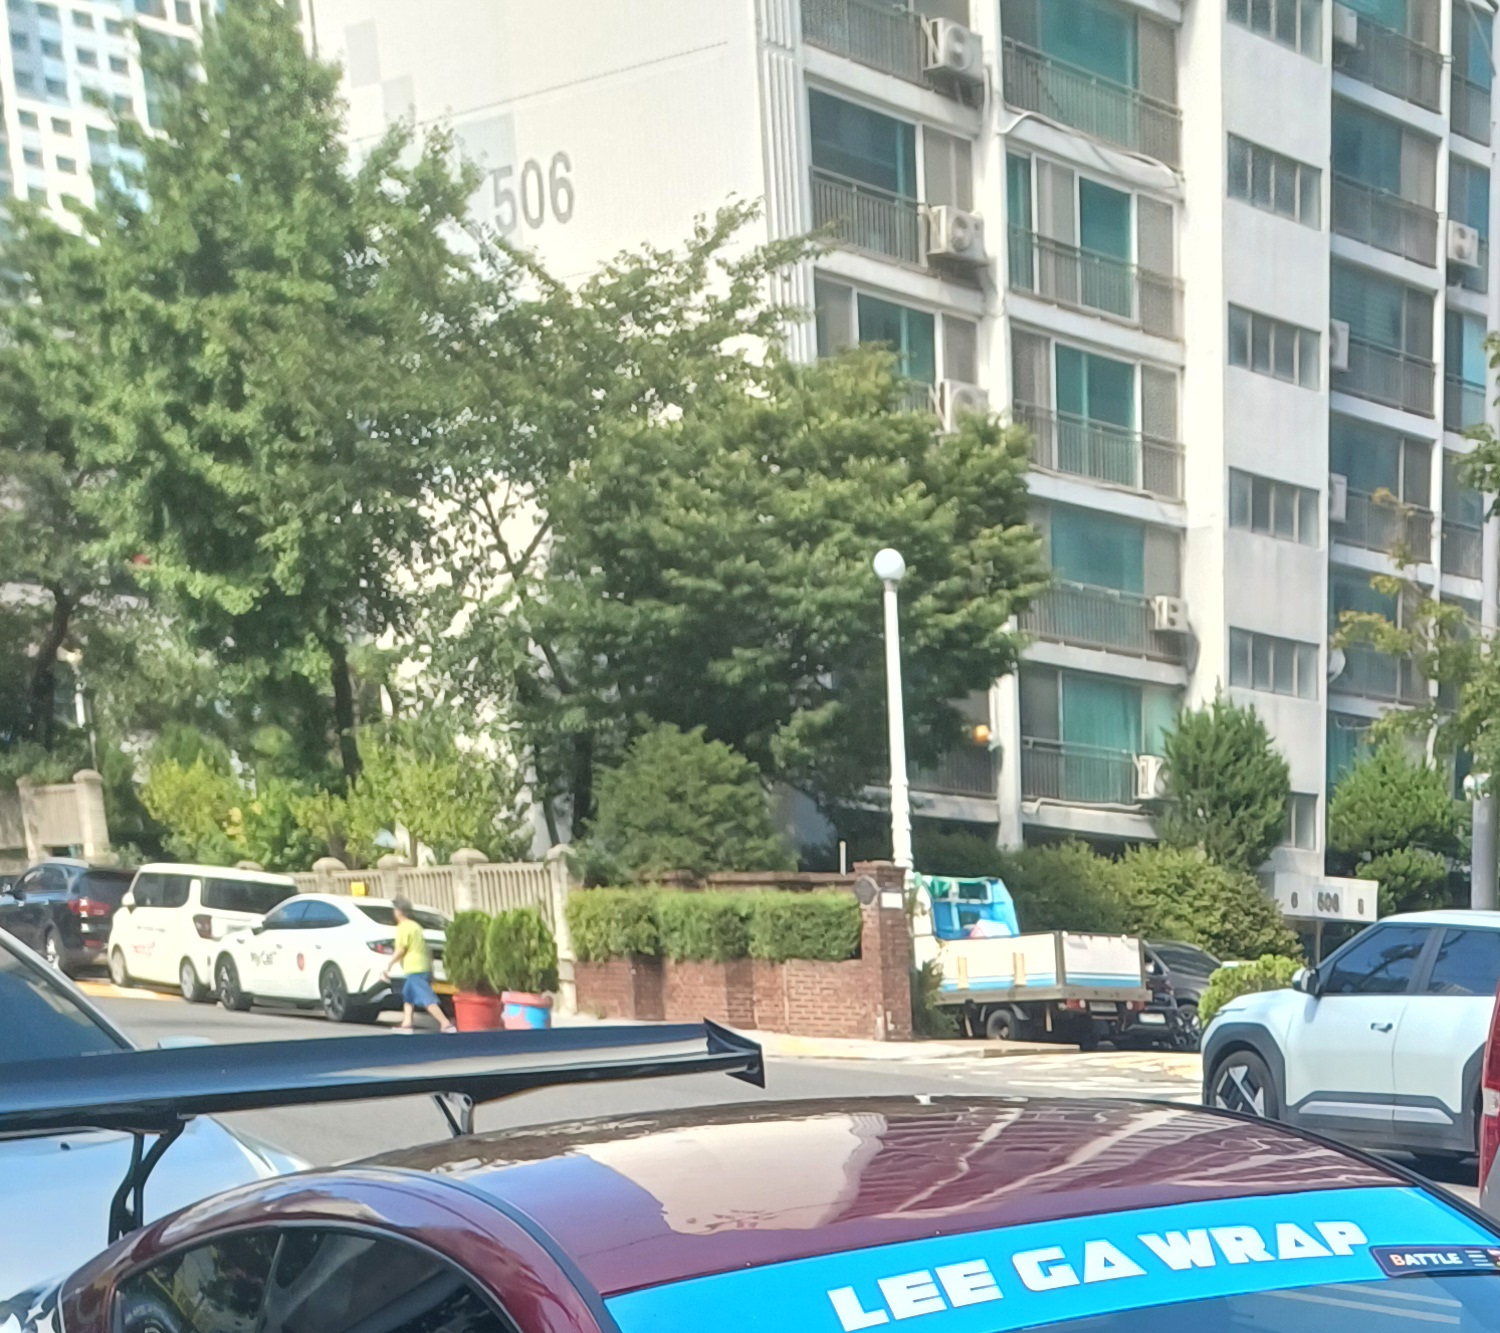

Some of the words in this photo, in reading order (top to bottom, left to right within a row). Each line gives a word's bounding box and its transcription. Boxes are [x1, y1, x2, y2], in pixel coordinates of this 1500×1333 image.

[489, 151, 574, 237] 506
[827, 1259, 1004, 1332] LEE
[1011, 1240, 1145, 1292] GA
[1137, 1221, 1369, 1271] WRAP
[1389, 1252, 1463, 1267] BATTLE
